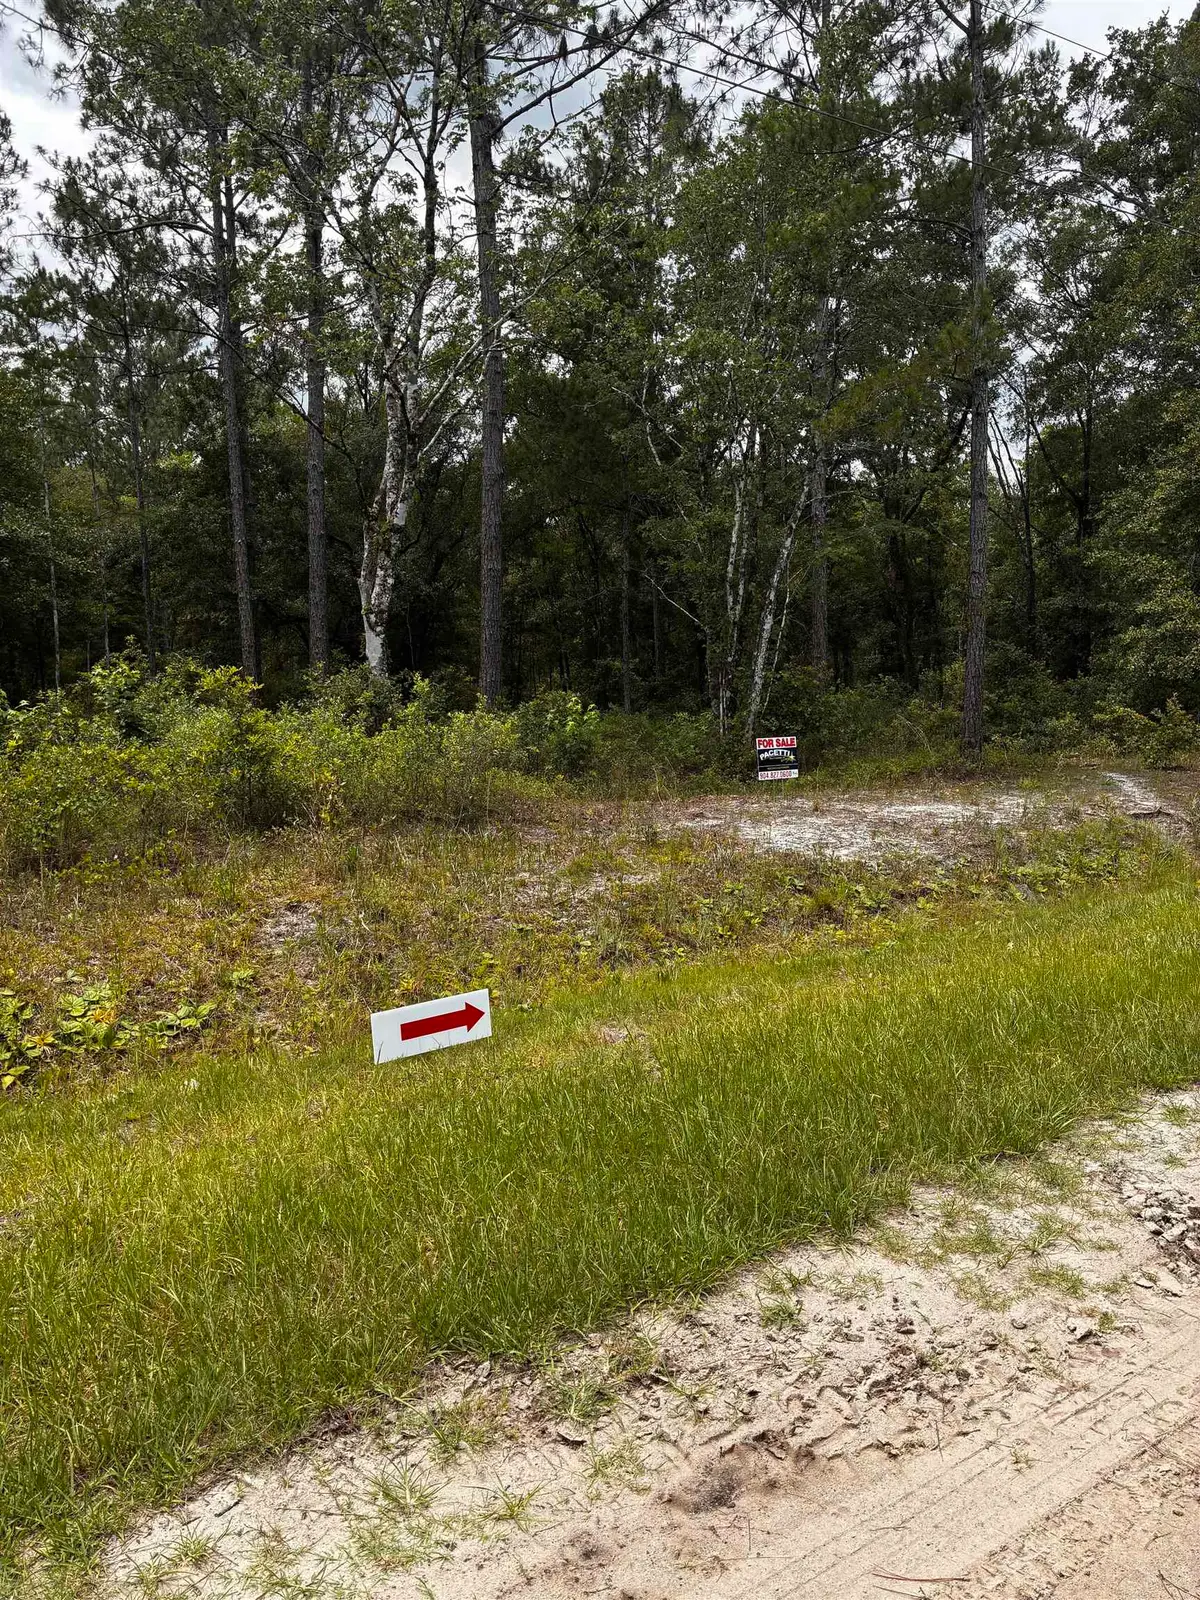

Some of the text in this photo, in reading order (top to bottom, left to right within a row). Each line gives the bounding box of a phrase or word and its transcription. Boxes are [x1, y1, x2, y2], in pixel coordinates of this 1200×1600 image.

[757, 738, 796, 748] FOR SALE
[759, 749, 791, 761] PACETTI
